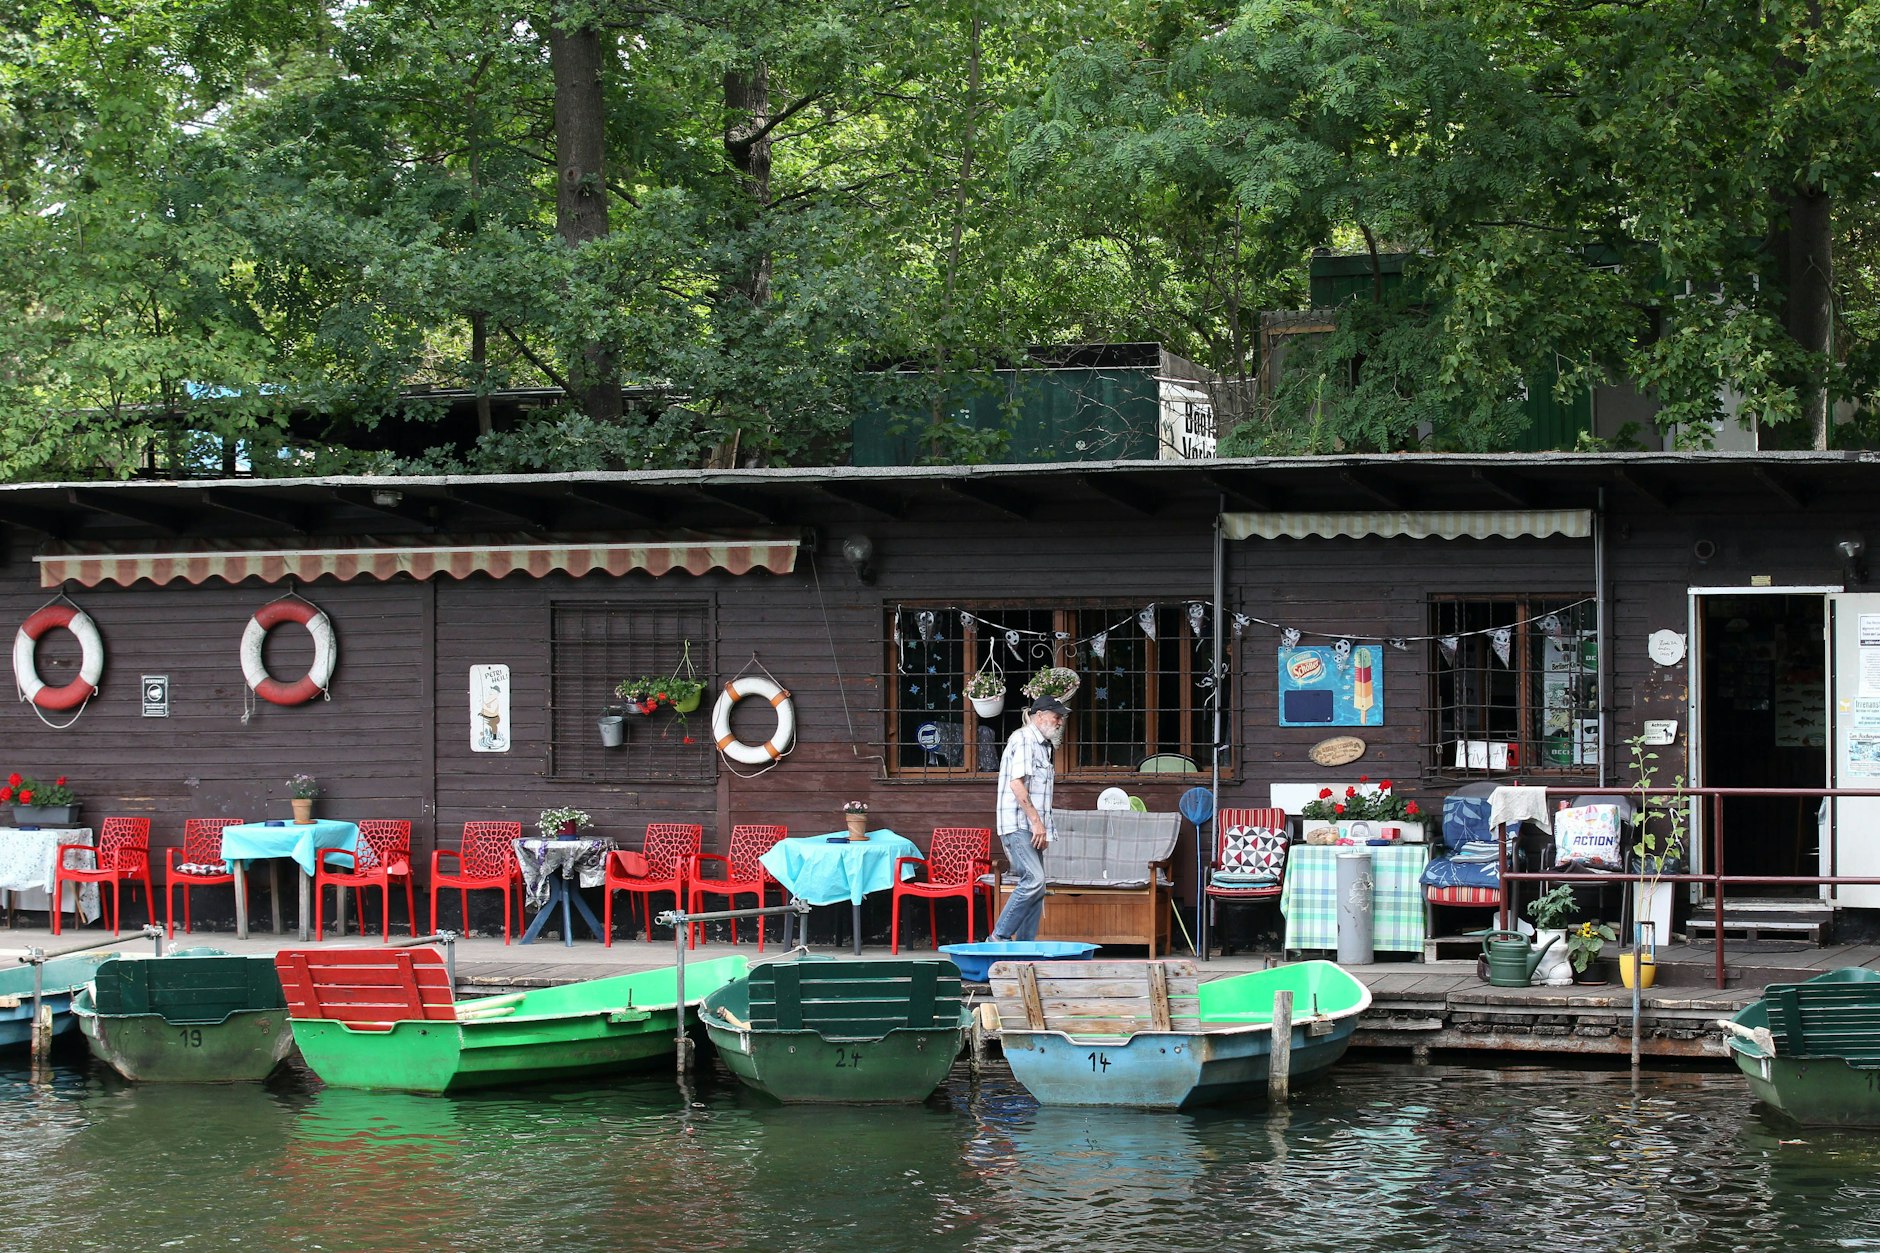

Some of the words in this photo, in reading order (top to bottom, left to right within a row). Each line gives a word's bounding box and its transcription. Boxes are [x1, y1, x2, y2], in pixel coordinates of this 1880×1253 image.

[484, 669, 503, 680] PETRI
[1573, 835, 1613, 846] ACTION
[179, 1029, 202, 1048] 19
[1088, 1051, 1112, 1073] 14
[1865, 1071, 1880, 1093] 1
